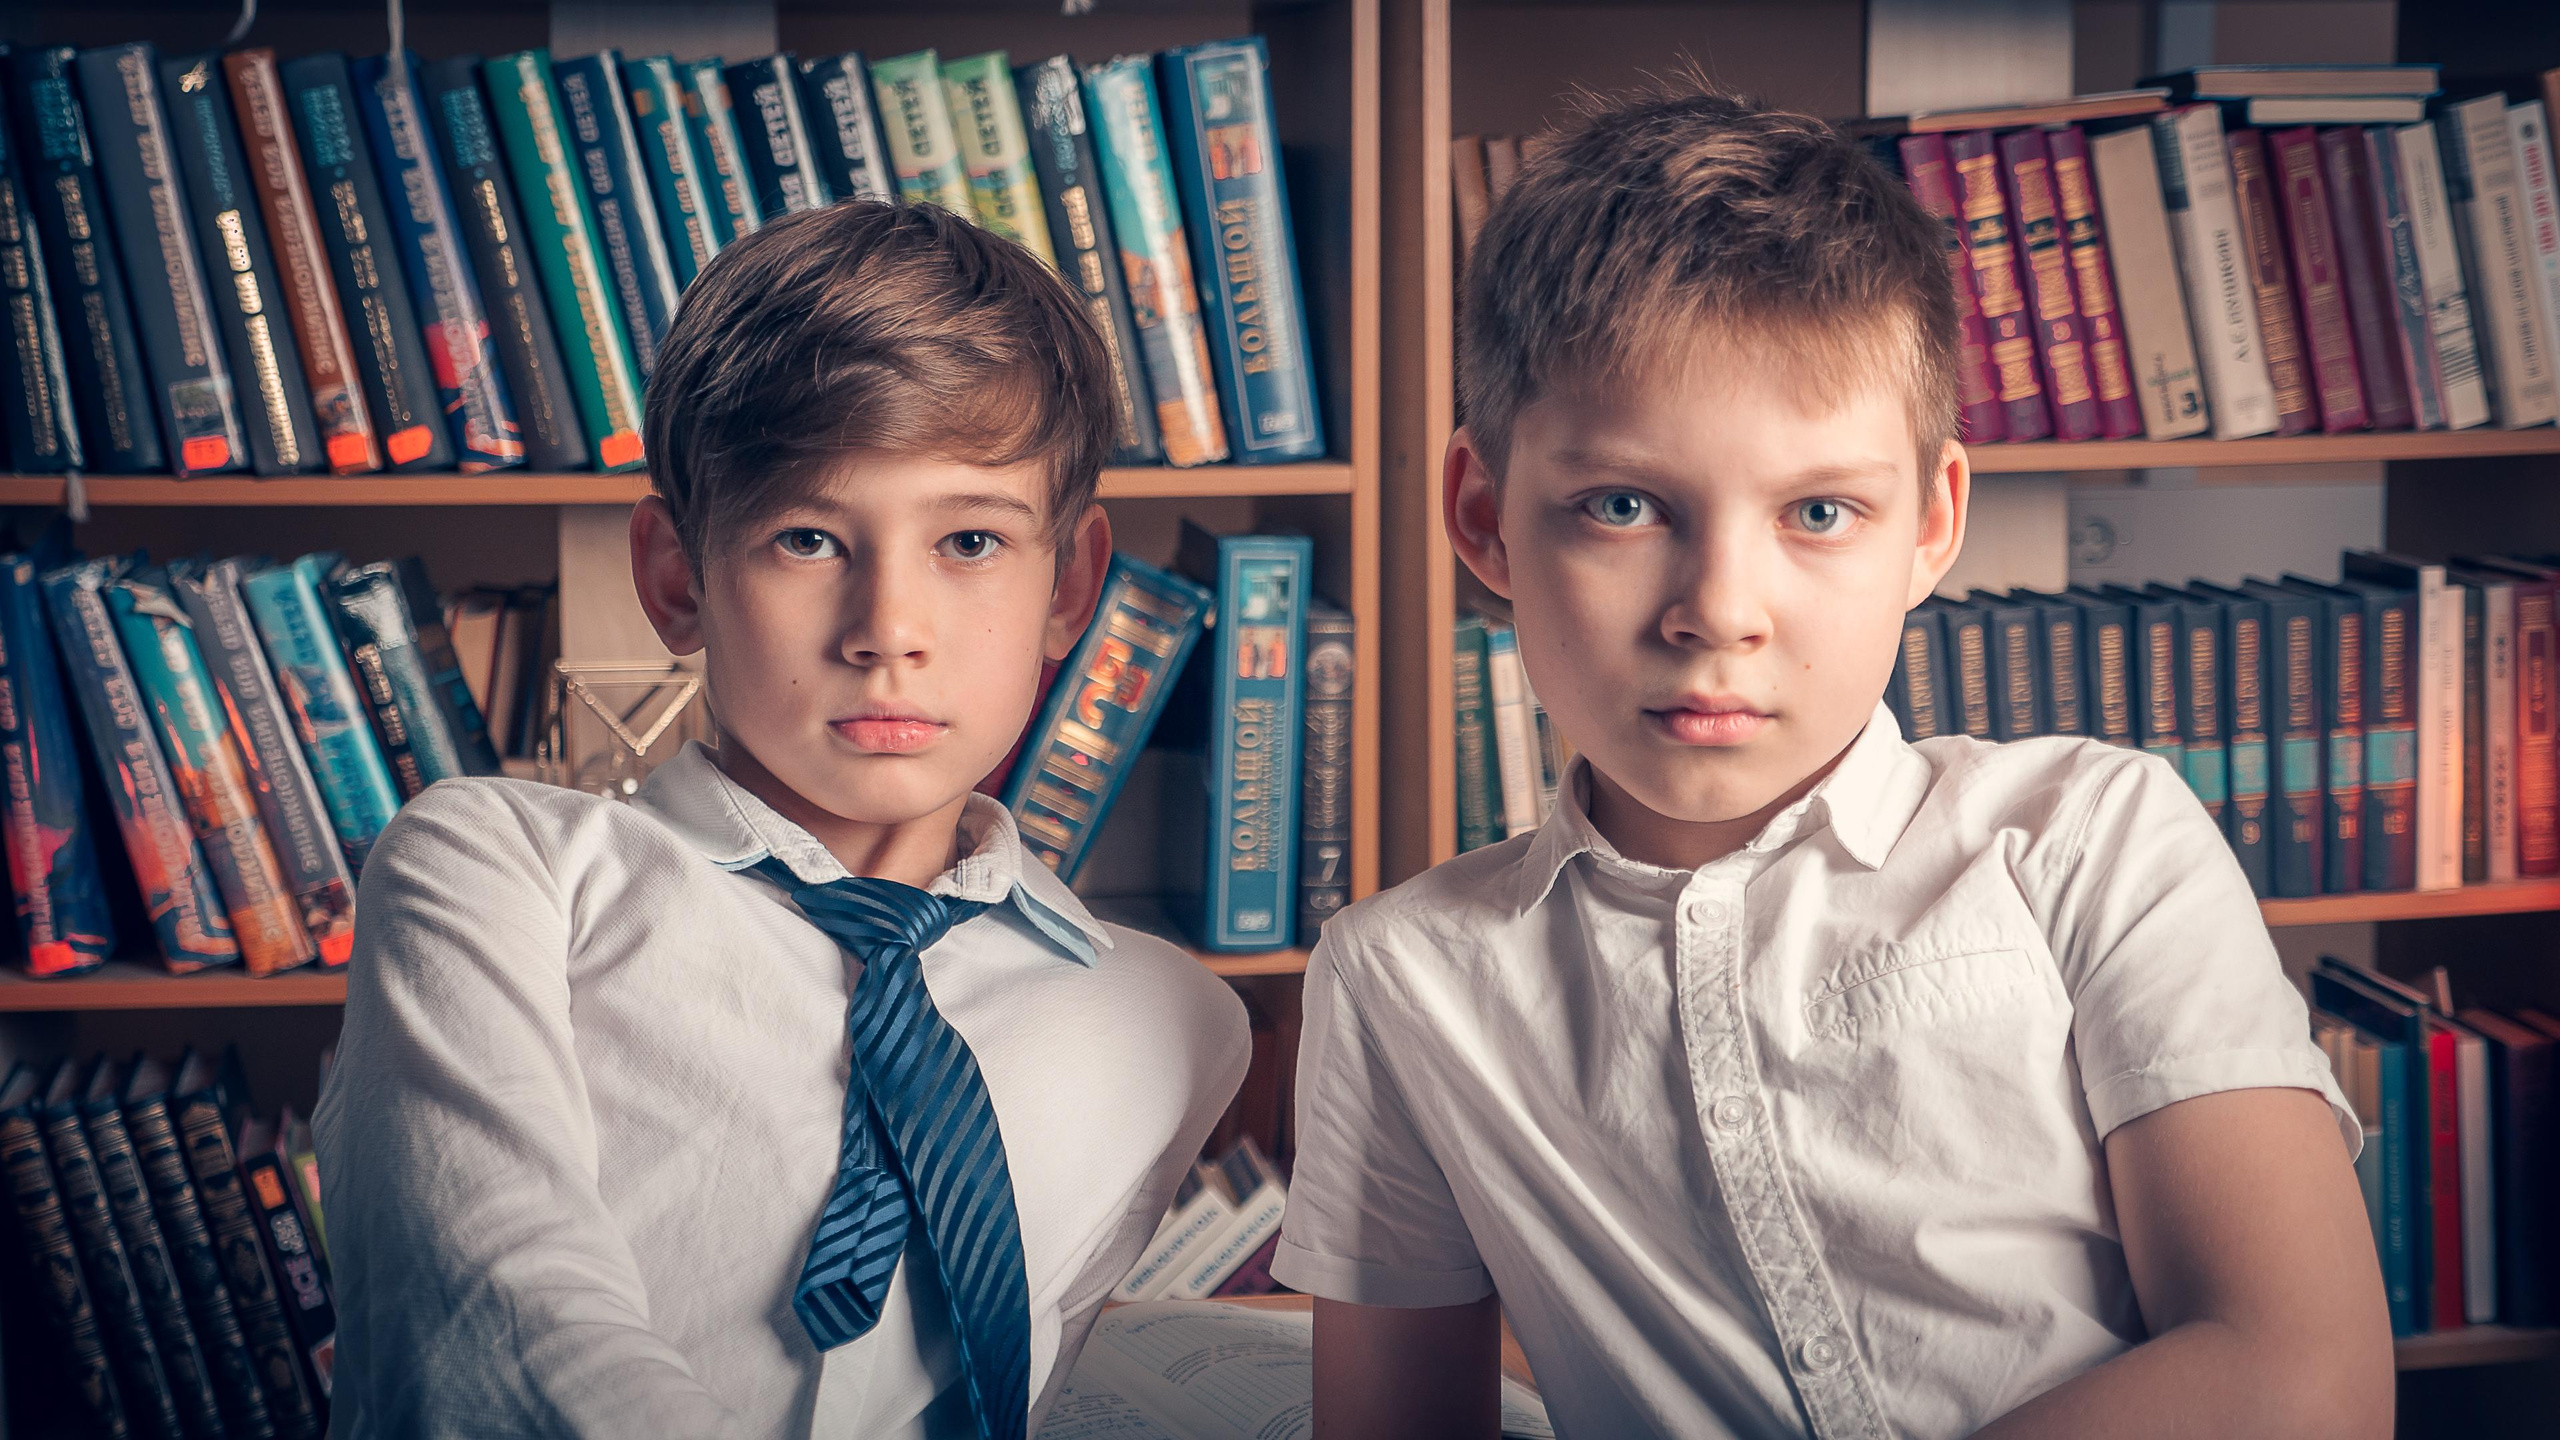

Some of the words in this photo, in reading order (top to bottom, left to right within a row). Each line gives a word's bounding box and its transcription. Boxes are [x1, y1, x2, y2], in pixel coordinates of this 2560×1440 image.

[560, 70, 601, 145] ДЕТЕЙ
[751, 80, 796, 168] ДЕТЕЙ
[821, 74, 864, 161] ДЕТЕЙ
[890, 76, 933, 158] ДЕТЕЙ
[960, 75, 1002, 159] ДЕТЕЙ
[1215, 197, 1270, 374] БОЛЬШОЙ
[2182, 391, 2199, 417] 3
[1231, 697, 1264, 871] БОЛЬШОЙ
[1318, 845, 1342, 882] 7
[2241, 820, 2261, 845] 9
